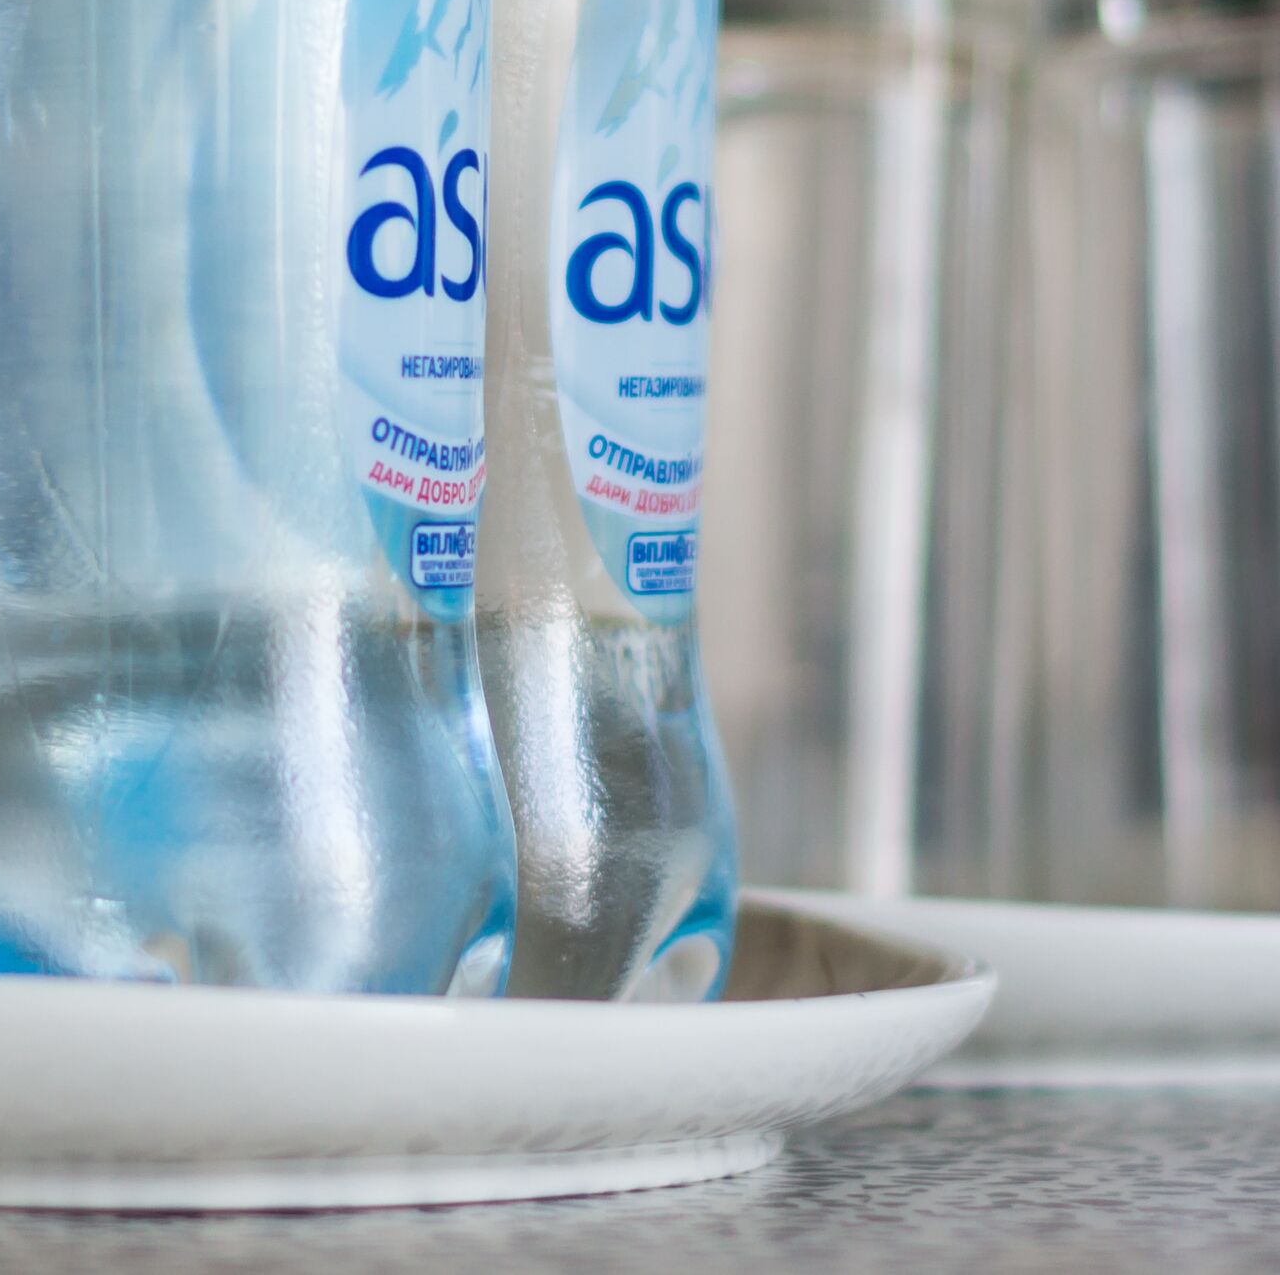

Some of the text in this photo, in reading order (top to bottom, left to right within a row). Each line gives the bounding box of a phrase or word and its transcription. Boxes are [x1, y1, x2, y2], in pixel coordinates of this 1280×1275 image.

[346, 145, 488, 302] as
[566, 179, 712, 326] as
[371, 417, 473, 472] ОТПРАВЛЯЙ
[588, 434, 692, 484] ОТПРАВЛЯЙ
[368, 461, 415, 496] ДАРИ
[417, 476, 466, 505] ДОБРО
[586, 474, 632, 506] ДАРИ
